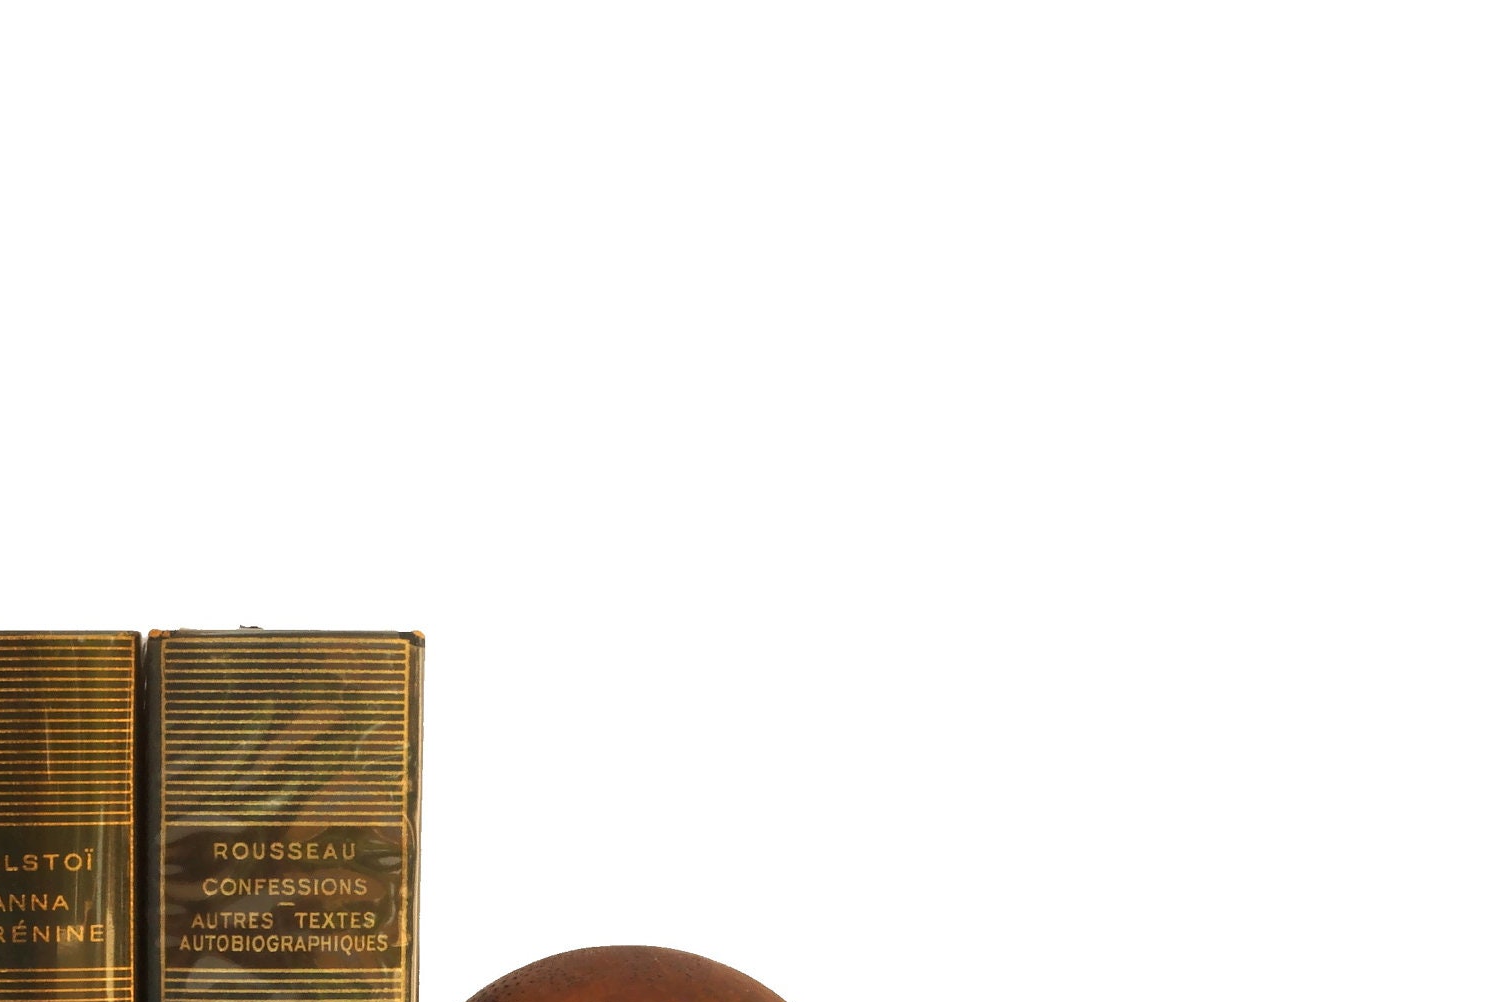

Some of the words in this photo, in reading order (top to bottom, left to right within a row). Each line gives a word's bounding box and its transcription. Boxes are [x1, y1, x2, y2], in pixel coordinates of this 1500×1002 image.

[213, 842, 356, 860] ROUSSEAU
[202, 878, 368, 896] CONFESSIONS
[191, 911, 274, 930] AUTRES
[294, 911, 376, 929] TEXTES
[179, 933, 389, 956] AUTOBIOGRAPHIQUES
